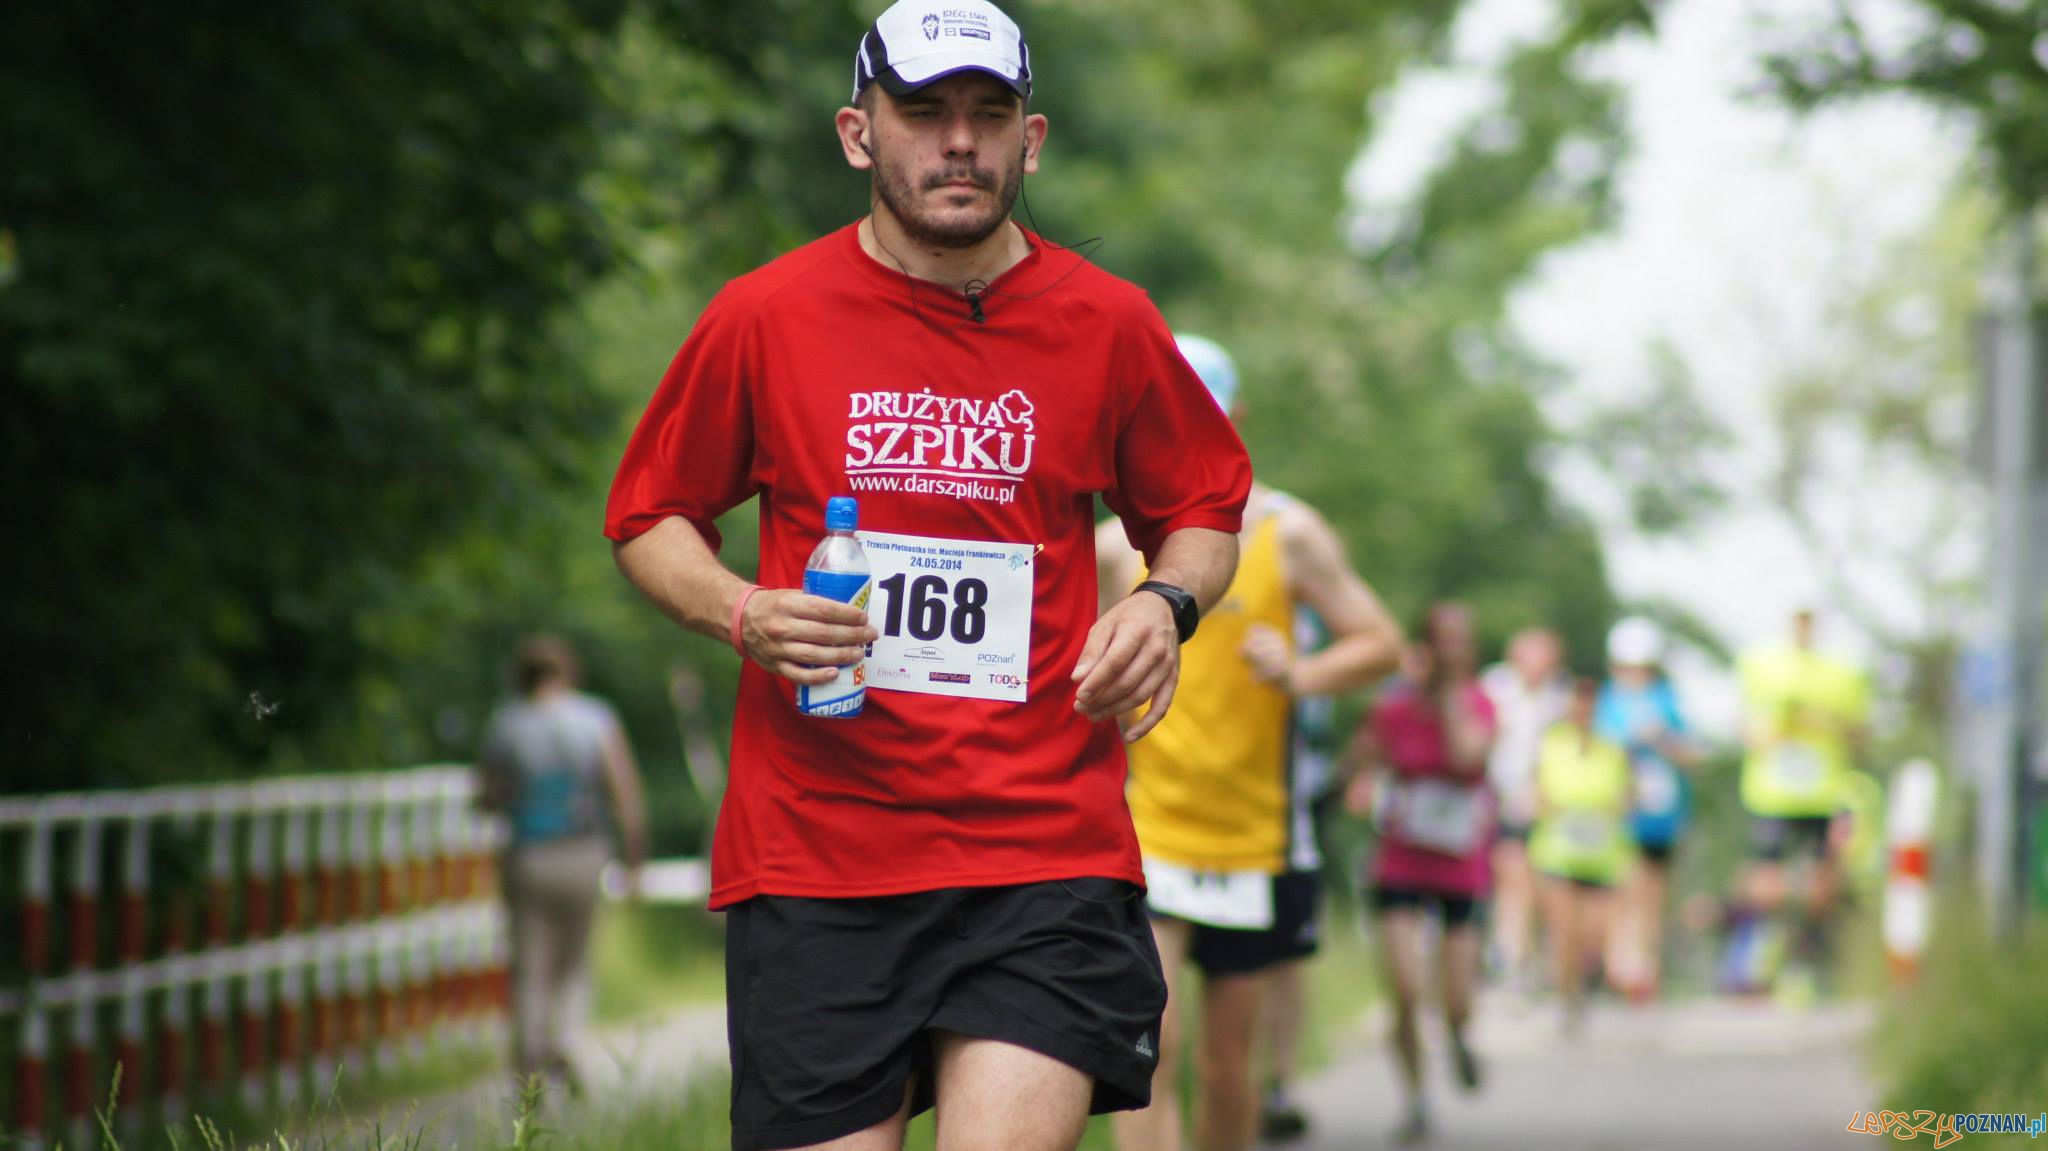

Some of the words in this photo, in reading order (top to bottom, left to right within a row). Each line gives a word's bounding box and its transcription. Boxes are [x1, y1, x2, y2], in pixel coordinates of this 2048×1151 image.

[849, 387, 1005, 428] DRUŻYNA
[845, 422, 1036, 474] SZPIKU
[849, 474, 1016, 504] www.darszpiku.pl
[910, 556, 962, 570] 24.05.2014
[878, 573, 988, 644] 168
